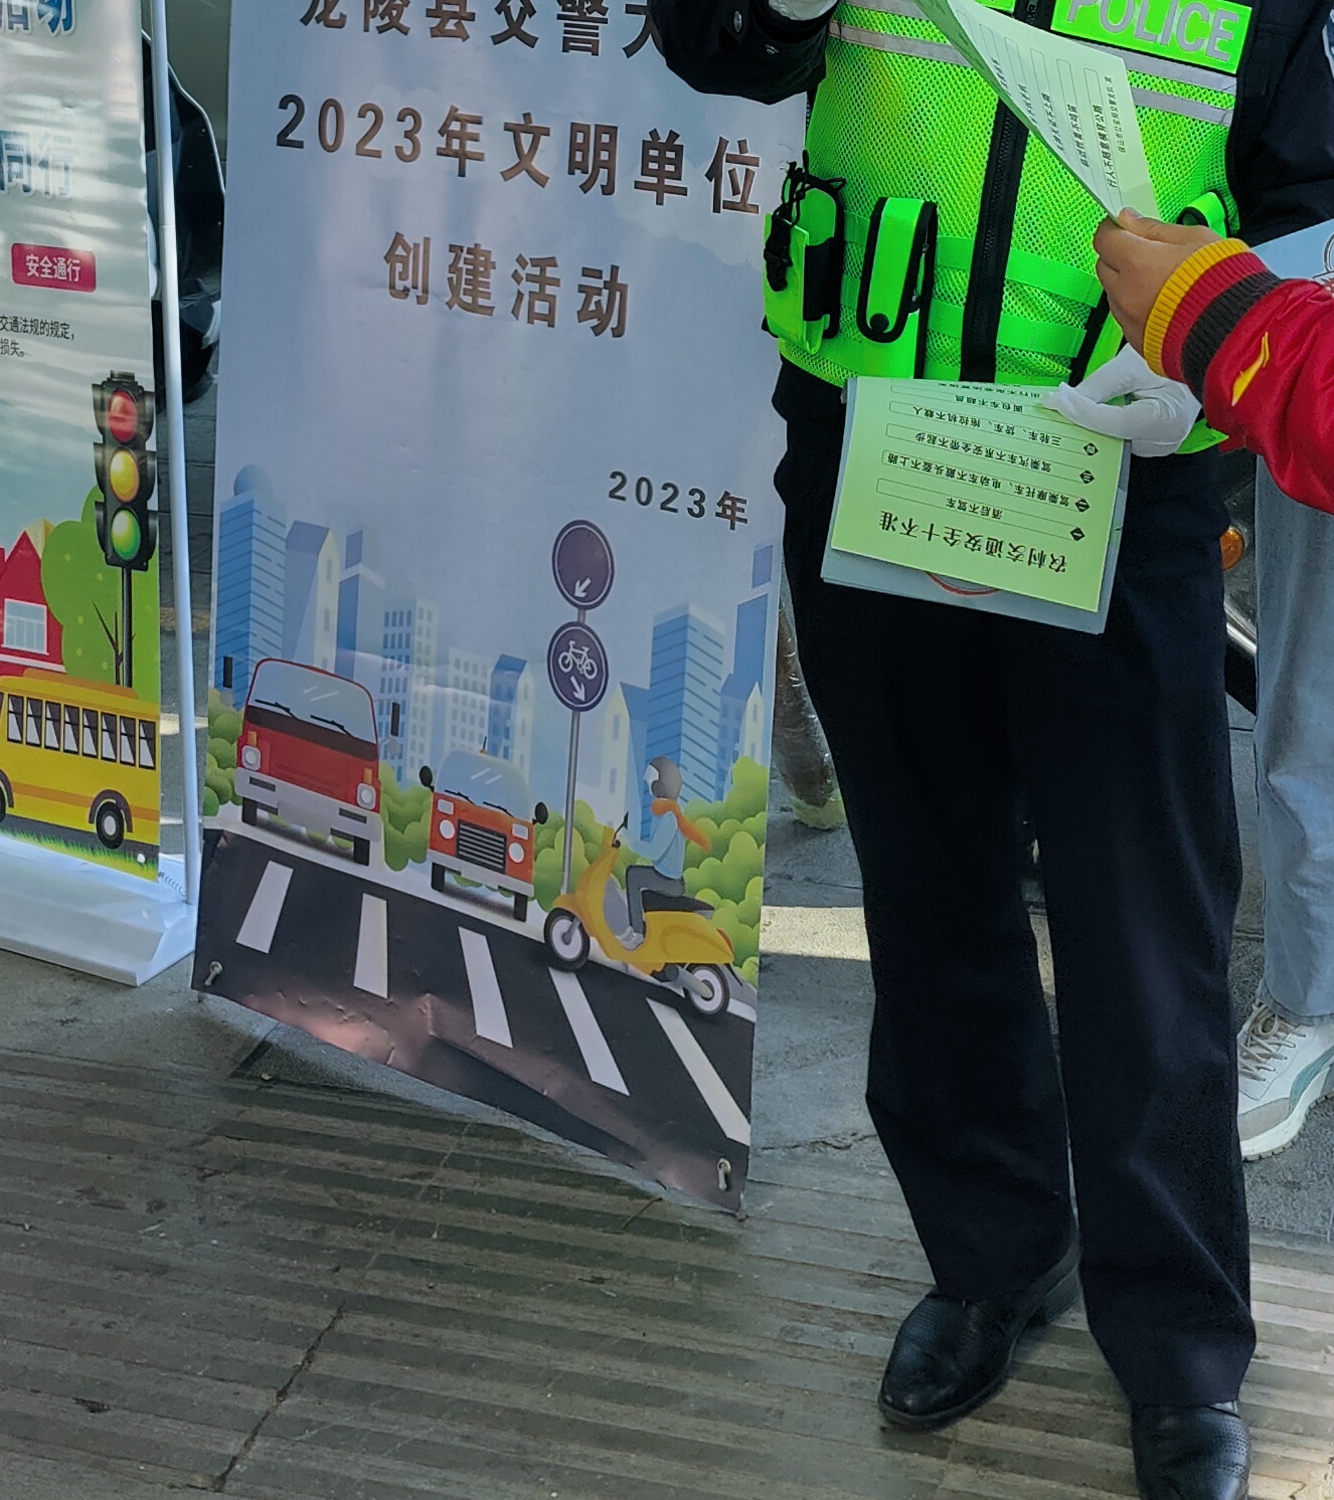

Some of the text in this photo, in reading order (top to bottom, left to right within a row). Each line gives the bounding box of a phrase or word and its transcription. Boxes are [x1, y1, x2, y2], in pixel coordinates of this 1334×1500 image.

[276, 94, 761, 214] 2023年文明单位
[25, 254, 82, 283] 安全通行
[384, 231, 629, 339] 创建活动
[607, 470, 749, 531] 2023年
[879, 509, 1068, 574] 农村交通安全十不准
